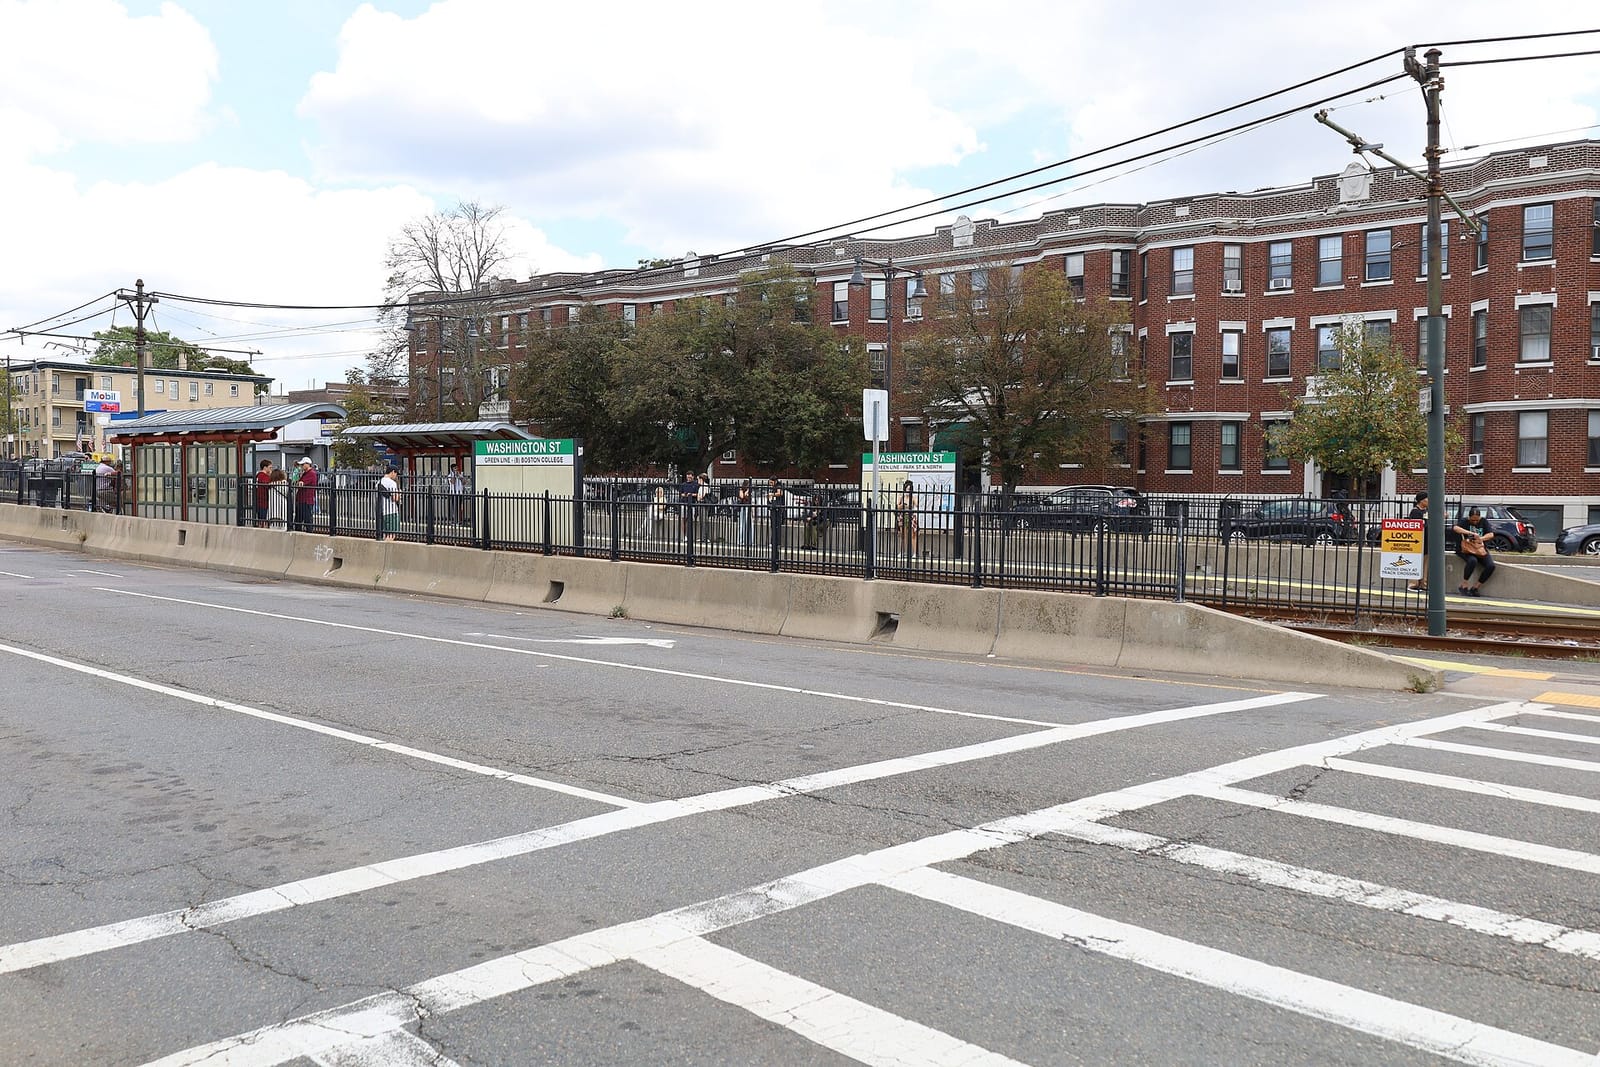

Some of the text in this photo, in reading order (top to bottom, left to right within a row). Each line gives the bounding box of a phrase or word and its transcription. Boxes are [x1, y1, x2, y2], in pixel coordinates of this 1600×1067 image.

[91, 391, 116, 401] Mobil
[486, 441, 561, 454] WASHINGTON ST
[933, 453, 944, 463] ST
[1385, 521, 1421, 529] DANGER
